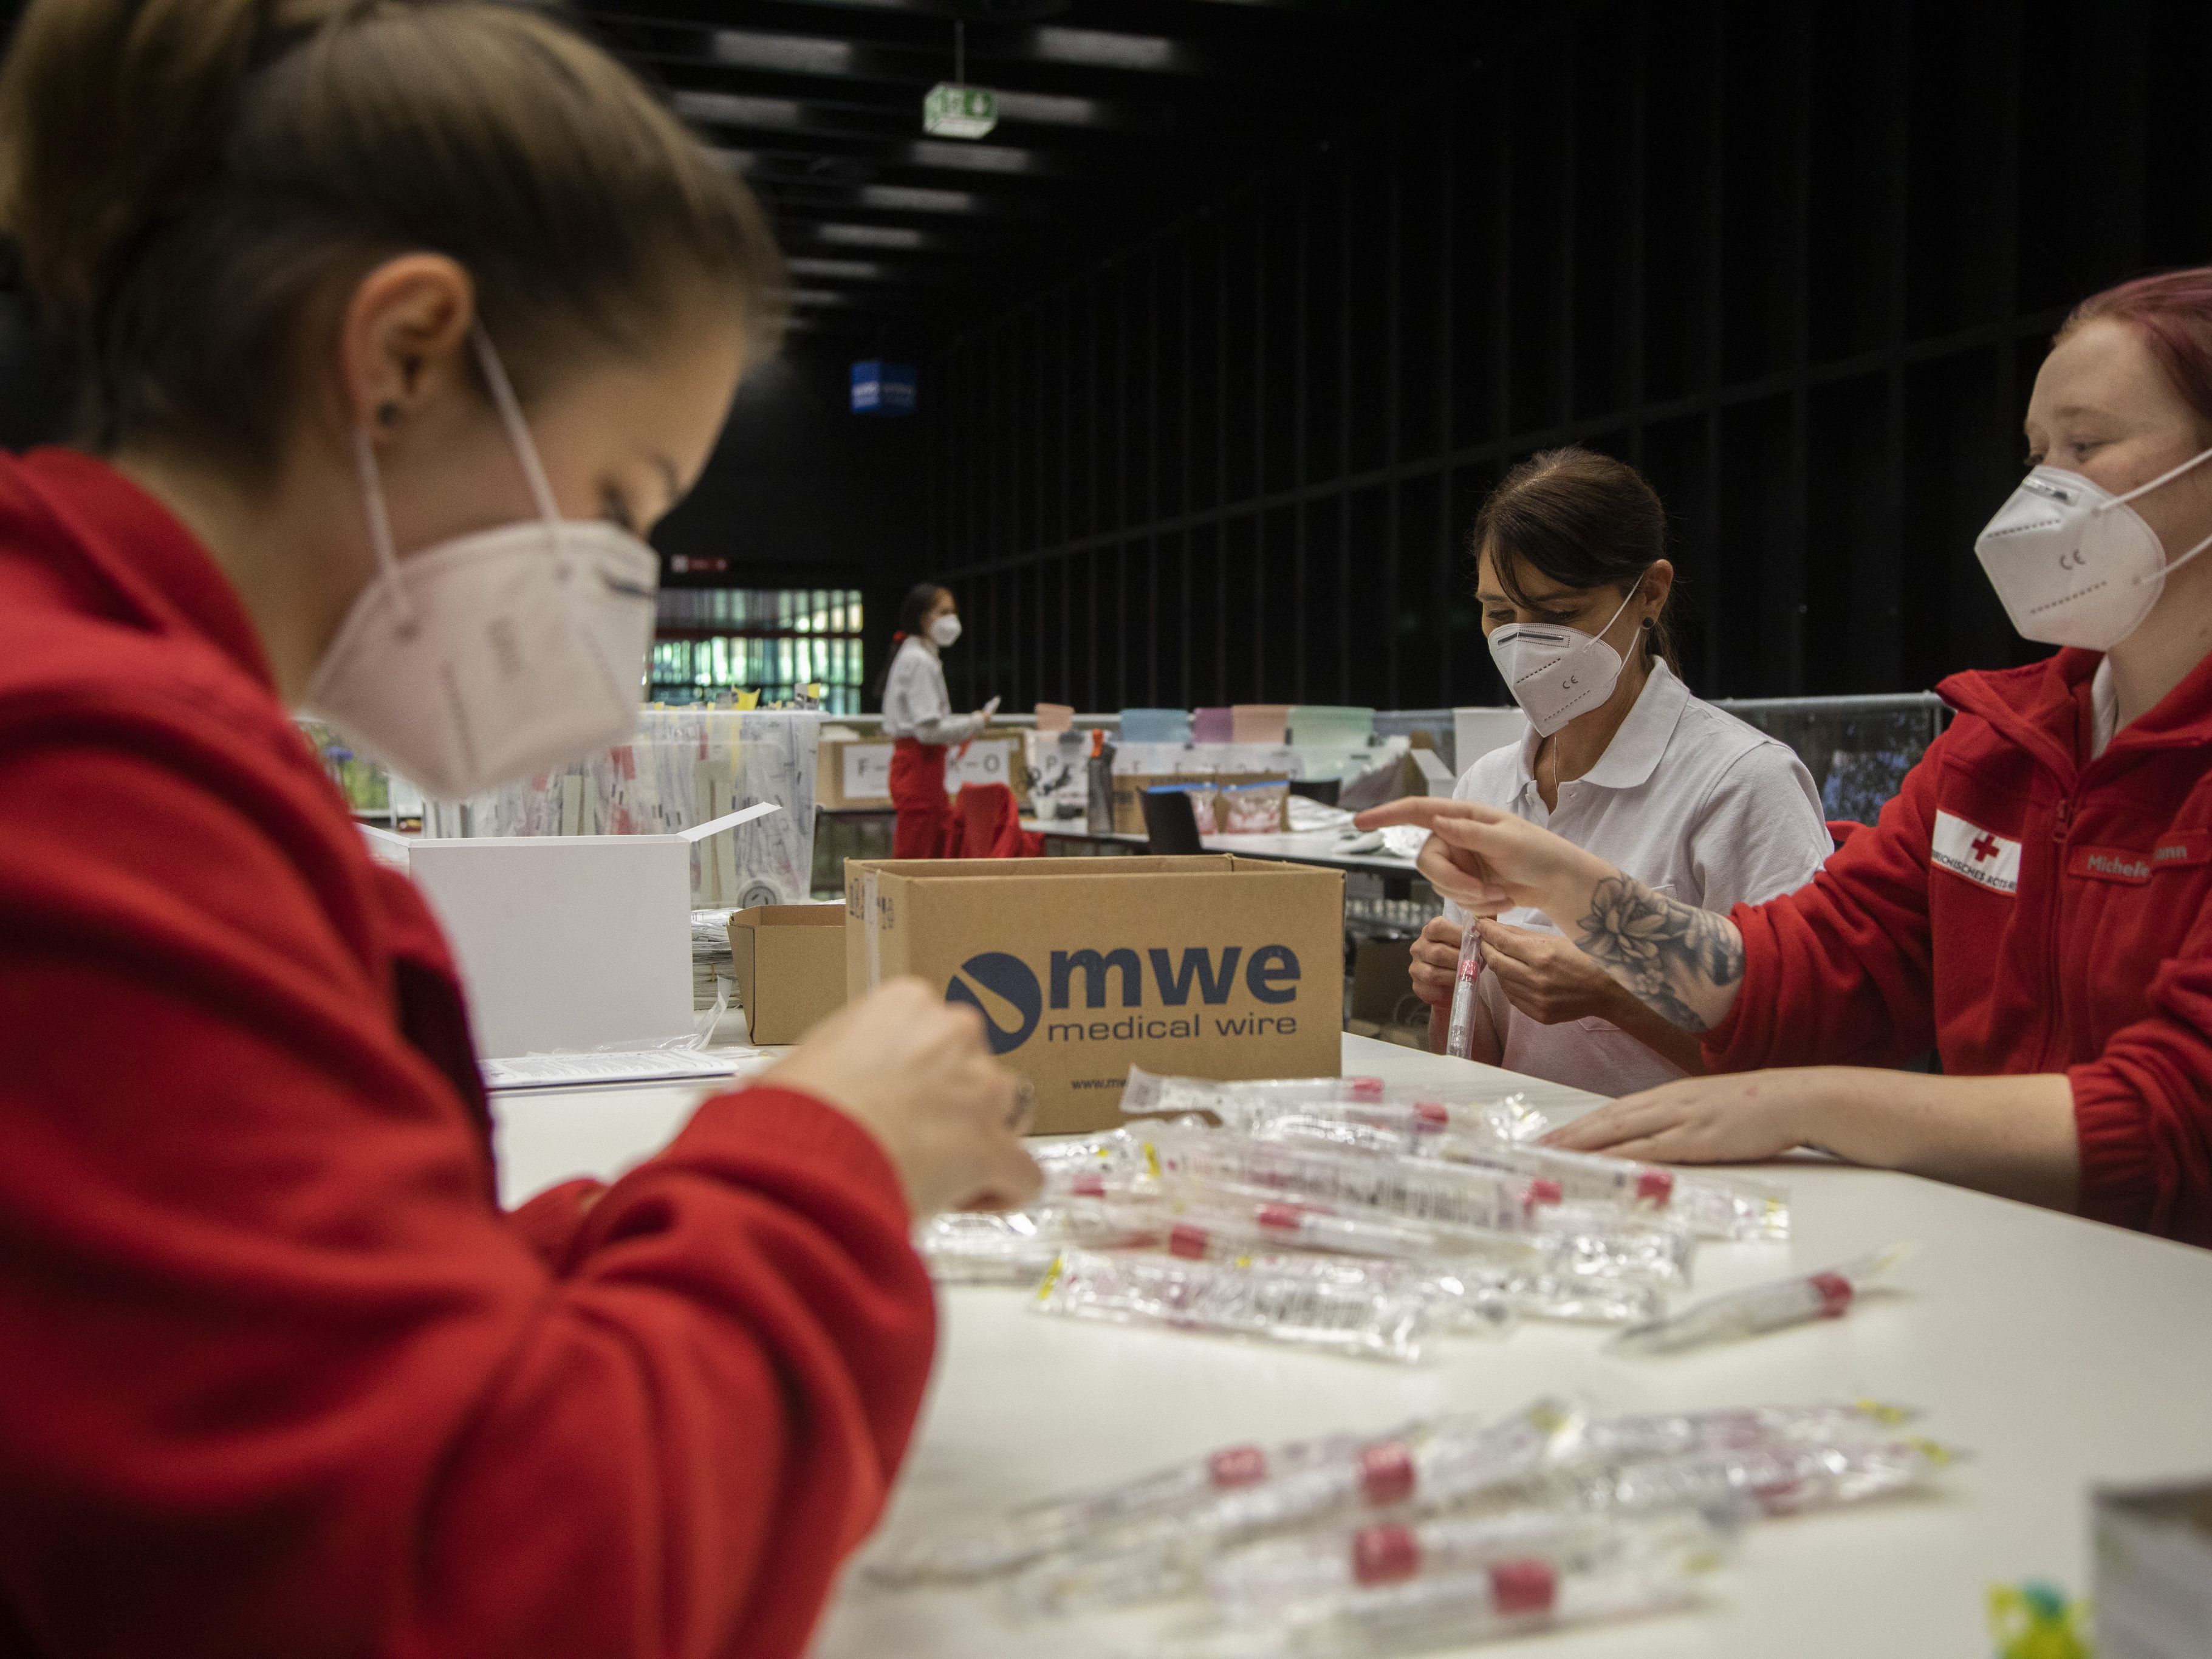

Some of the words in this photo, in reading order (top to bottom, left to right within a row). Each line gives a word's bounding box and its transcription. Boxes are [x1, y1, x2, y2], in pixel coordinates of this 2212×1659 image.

[2059, 549, 2086, 571] CE
[1562, 675, 1578, 690] CE
[1049, 943, 1301, 1010] mwe
[1048, 1013, 1200, 1042] medical
[1214, 1012, 1297, 1037] wire
[1071, 1078, 1126, 1089] www.mw
